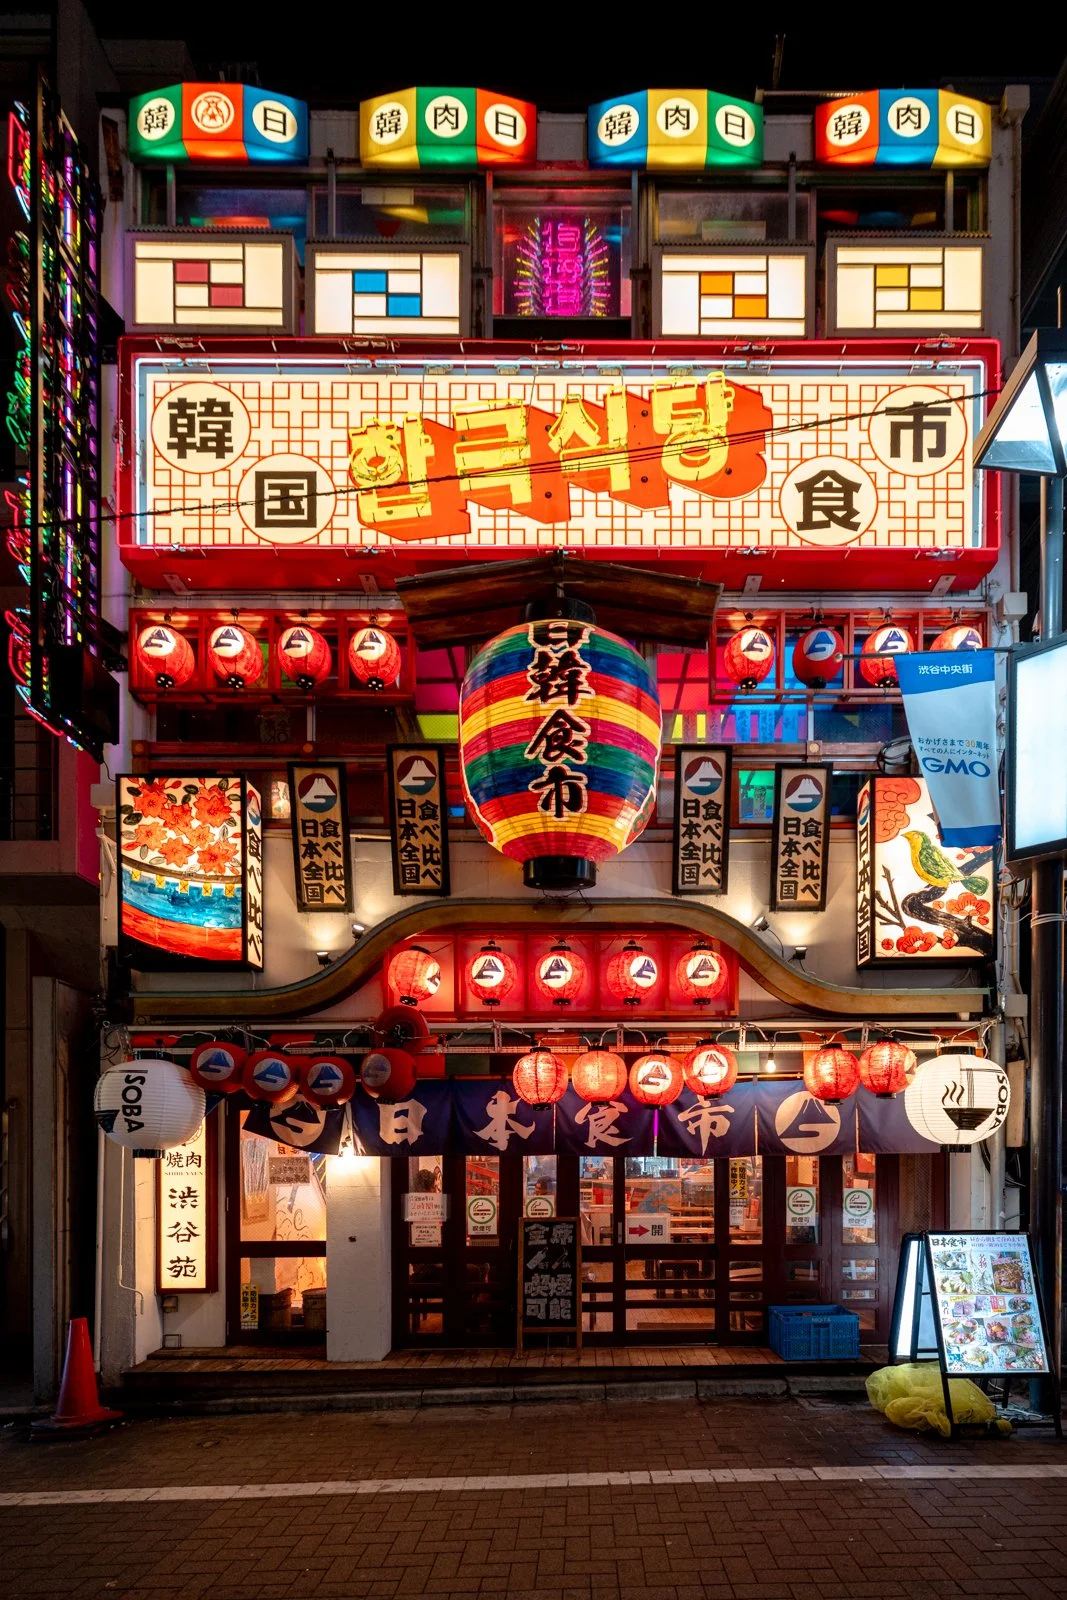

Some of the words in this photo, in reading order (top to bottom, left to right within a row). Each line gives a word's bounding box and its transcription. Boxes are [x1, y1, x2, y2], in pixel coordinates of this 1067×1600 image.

[143, 104, 168, 135] 韓
[263, 108, 288, 134] 日
[375, 110, 402, 139] 韓
[434, 103, 460, 130] 肉
[494, 112, 518, 140] 日
[604, 110, 632, 140] 韓
[665, 104, 691, 131] 肉
[724, 111, 746, 139] 日
[834, 110, 863, 140] 韓
[896, 104, 922, 130] 肉
[955, 110, 976, 137] 日
[167, 397, 233, 460] 韓
[349, 370, 735, 523] 한국식당
[885, 401, 951, 462] 市
[255, 471, 317, 528] 国
[795, 469, 862, 532] 食
[918, 663, 973, 675] 渋谷中央街
[525, 622, 594, 819] 日韓食市
[918, 737, 990, 750] おかげさまで30周年
[919, 746, 990, 759] すべての人にインターネット
[921, 756, 991, 777] GMO
[301, 818, 325, 903] 日本全国
[321, 818, 346, 902] 食べ比べ
[397, 799, 420, 885] 日本全国
[418, 800, 442, 885] 食べ比べ
[680, 799, 702, 885] 日本全国
[701, 800, 722, 884] 食べ比べ
[779, 817, 801, 900] 日本全国
[801, 818, 822, 900] 食べ比べ
[858, 822, 870, 961] 日本全国
[121, 1074, 146, 1133] SOBA
[988, 1074, 1011, 1131] SOBA
[166, 1151, 202, 1168] 焼肉
[167, 1186, 200, 1278] 渋谷苑
[525, 1222, 574, 1245] 全席
[651, 1224, 663, 1236] 開
[931, 1236, 968, 1248] 日本食市
[525, 1273, 573, 1297] 喫煙
[526, 1297, 572, 1320] 可能
